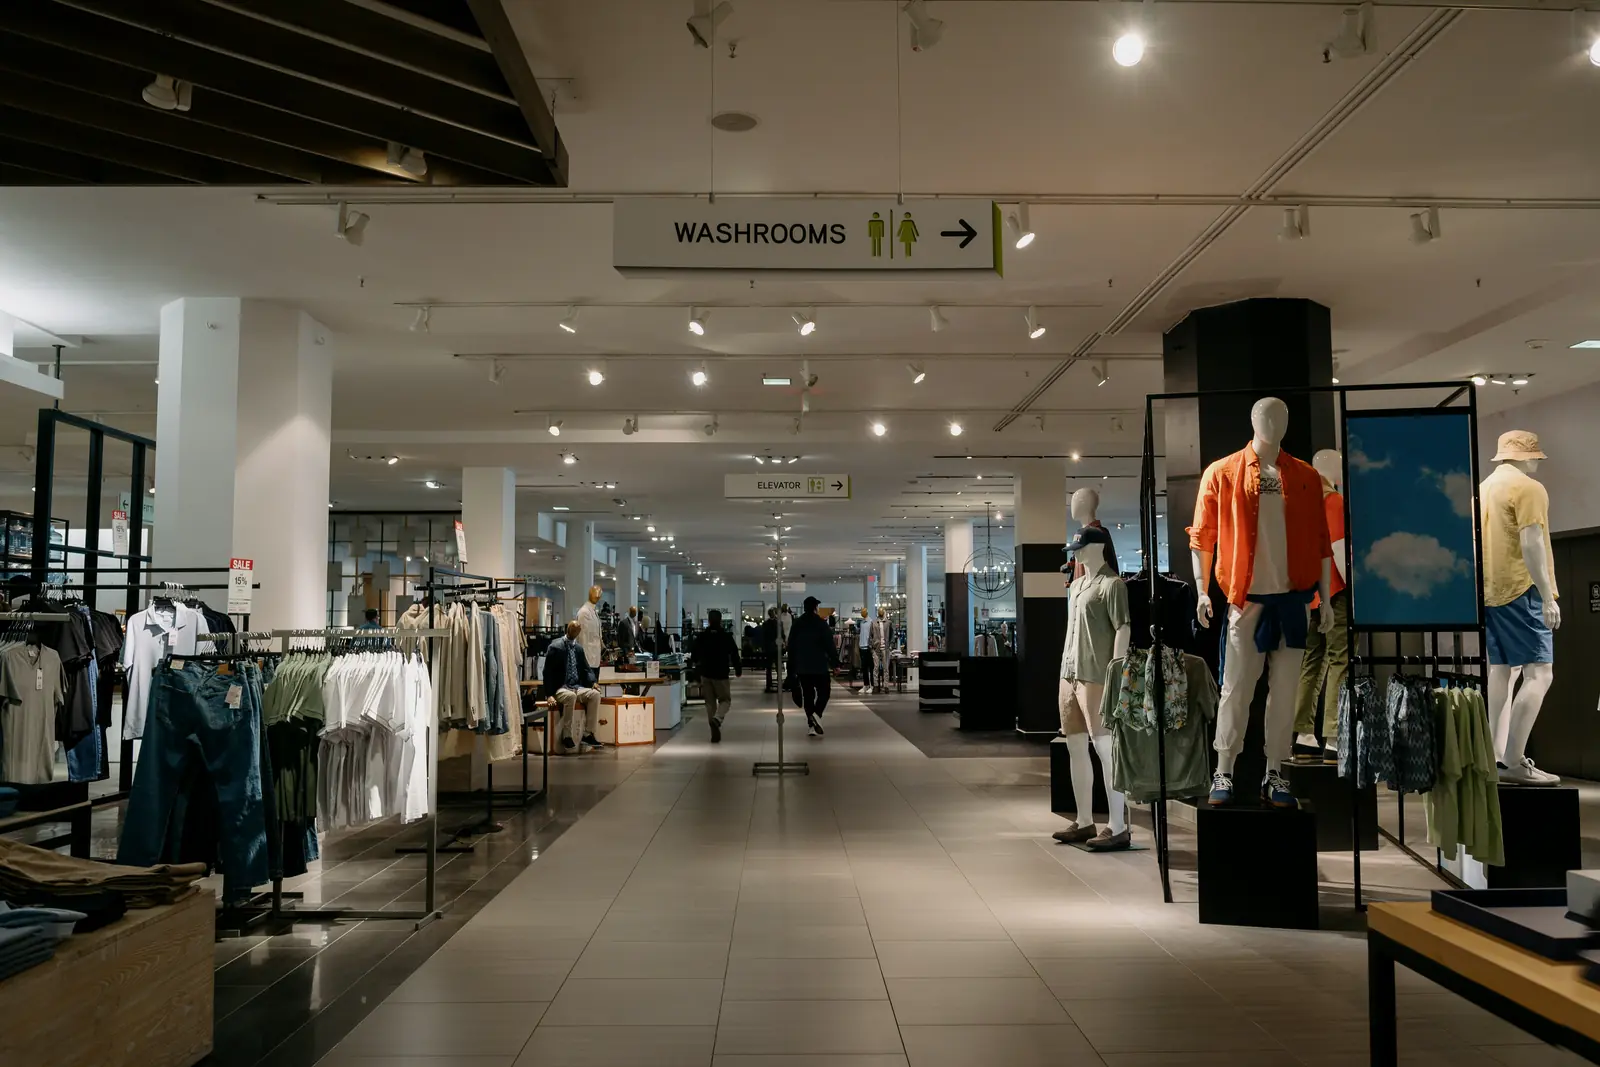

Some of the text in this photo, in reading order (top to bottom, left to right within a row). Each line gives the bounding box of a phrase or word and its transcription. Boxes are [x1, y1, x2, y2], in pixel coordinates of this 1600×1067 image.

[674, 222, 846, 245] WASHROOMS
[757, 481, 801, 490] ELEVATOR
[113, 511, 126, 520] SALE
[232, 560, 251, 570] SALE
[235, 577, 247, 585] 15%
